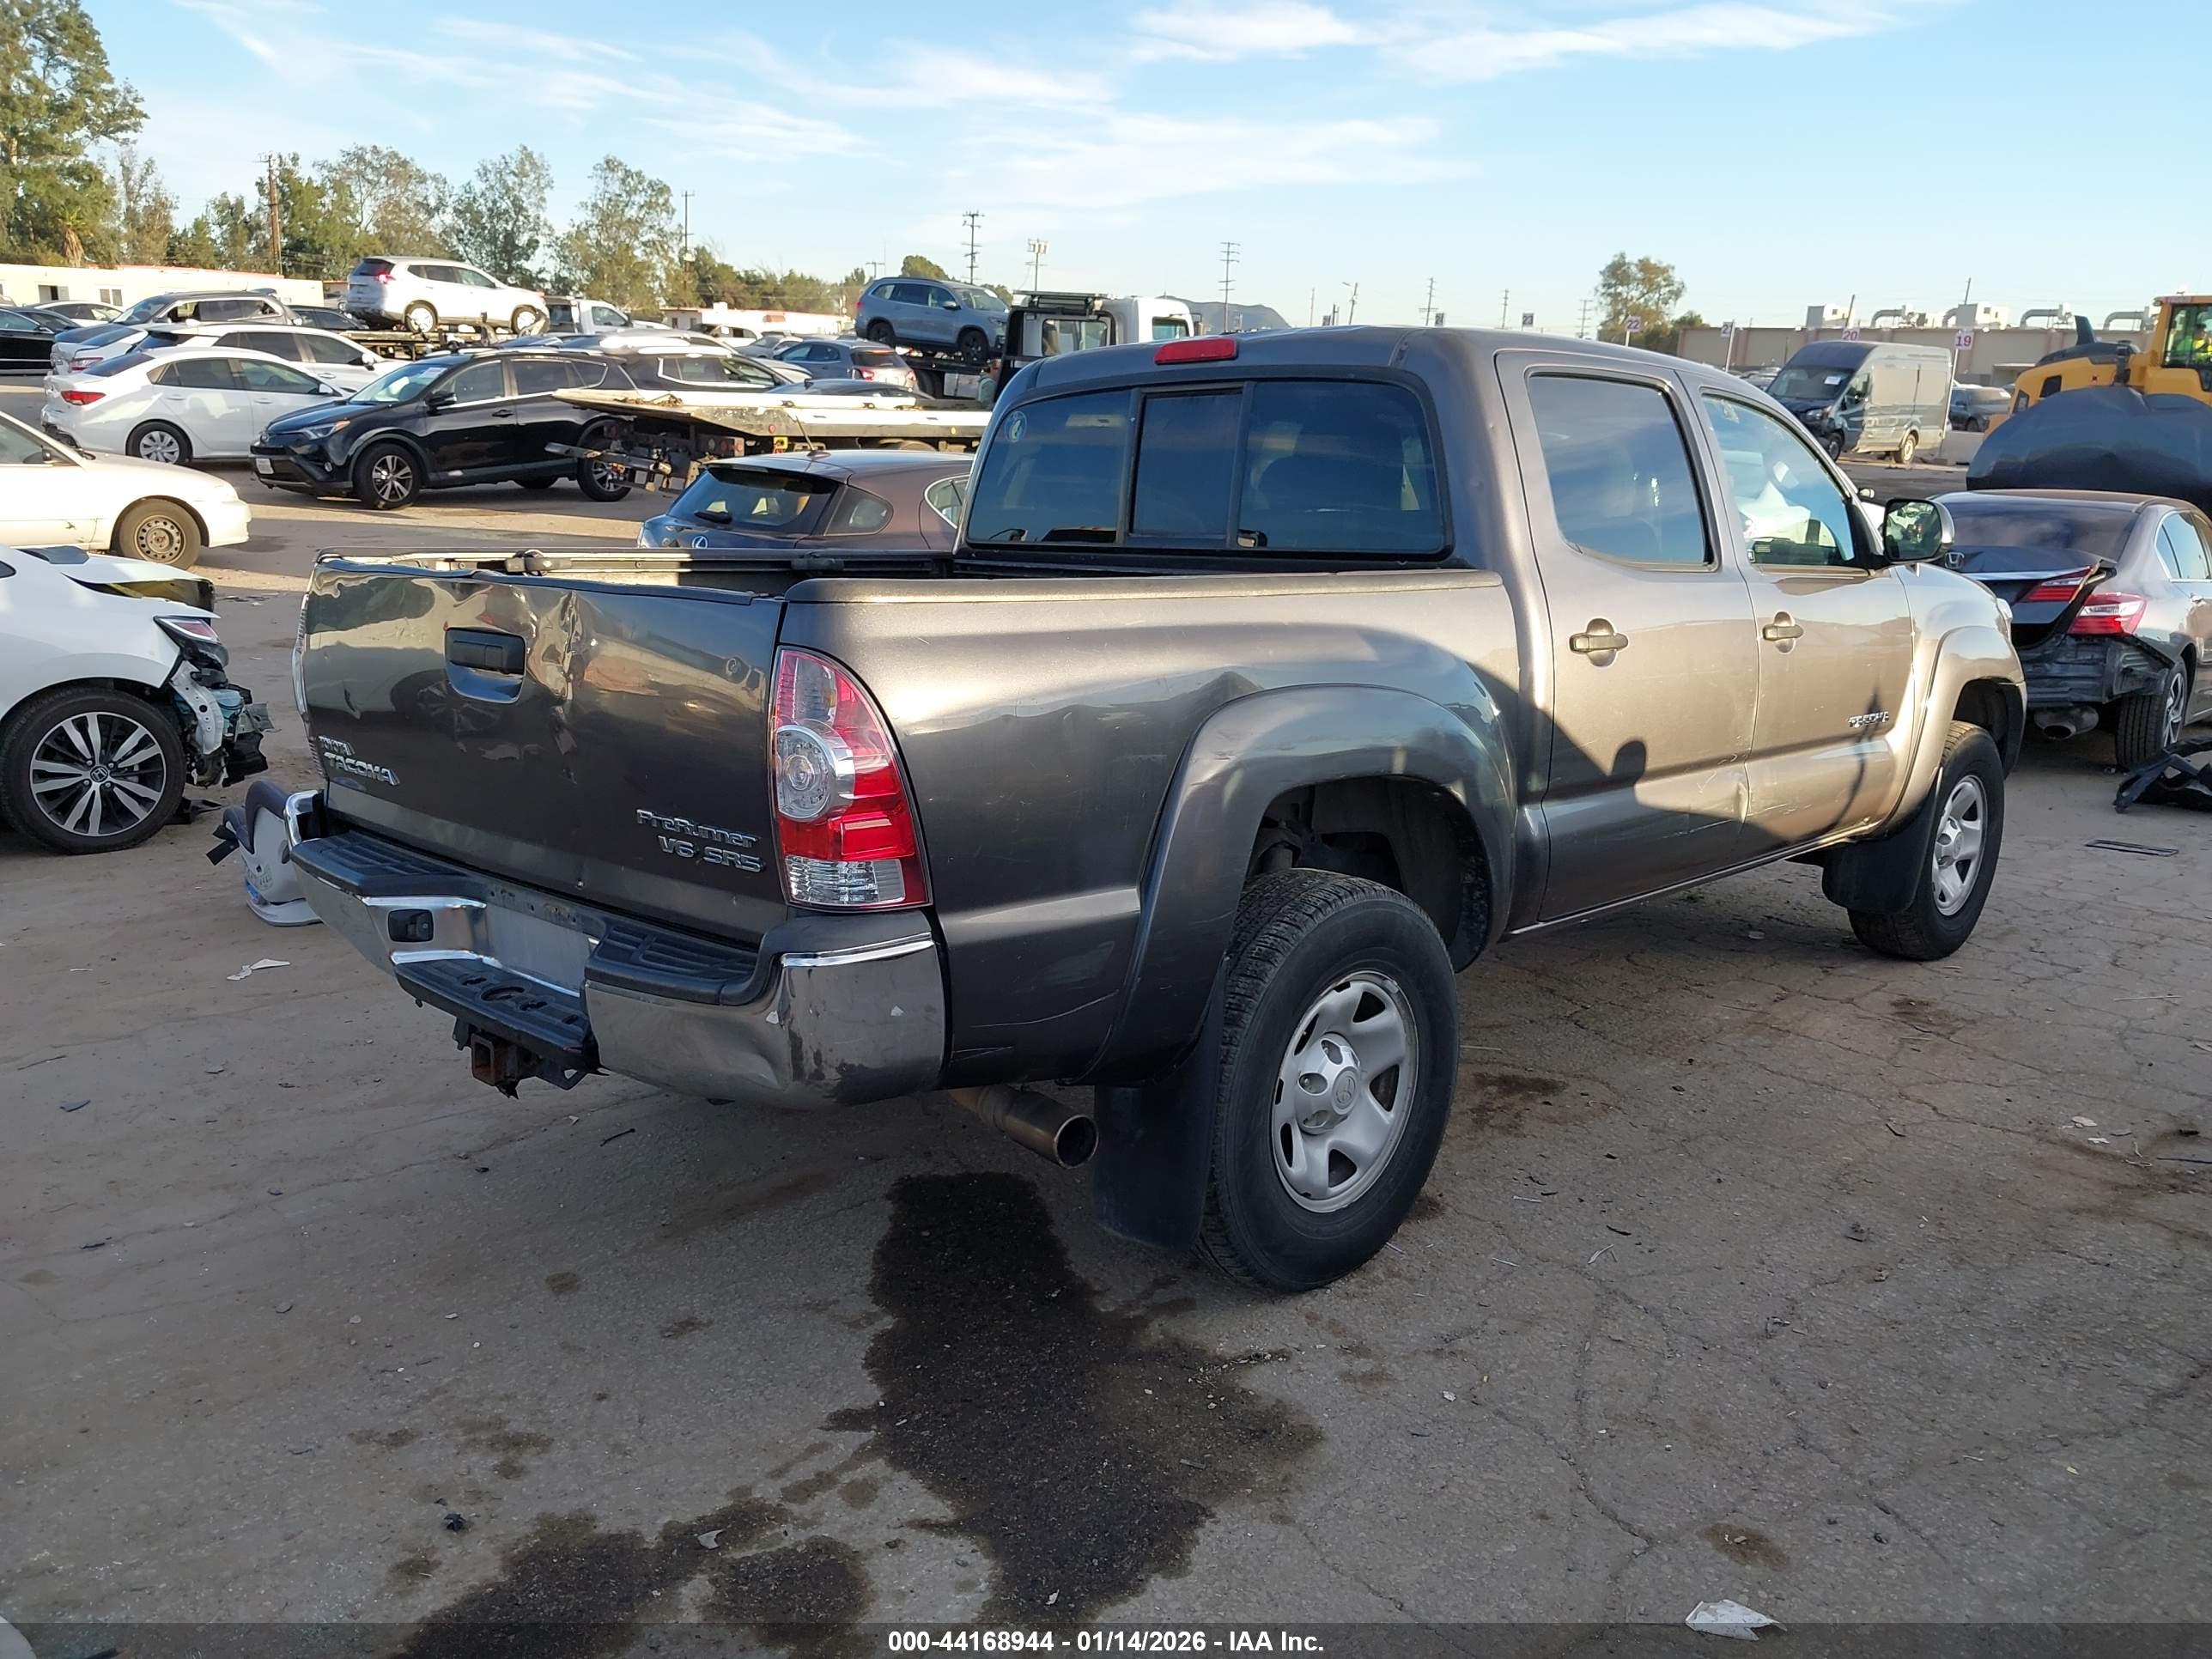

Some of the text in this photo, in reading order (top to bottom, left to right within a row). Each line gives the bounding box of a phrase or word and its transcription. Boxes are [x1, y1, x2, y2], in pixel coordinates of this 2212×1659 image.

[1627, 319, 1640, 330] 22
[1843, 331, 1858, 341] 20
[1955, 336, 1972, 347] 19
[318, 735, 356, 756] TOYOTA
[324, 751, 400, 786] TACOMA
[636, 809, 761, 848] PreRunner
[658, 835, 763, 872] V6 SR5
